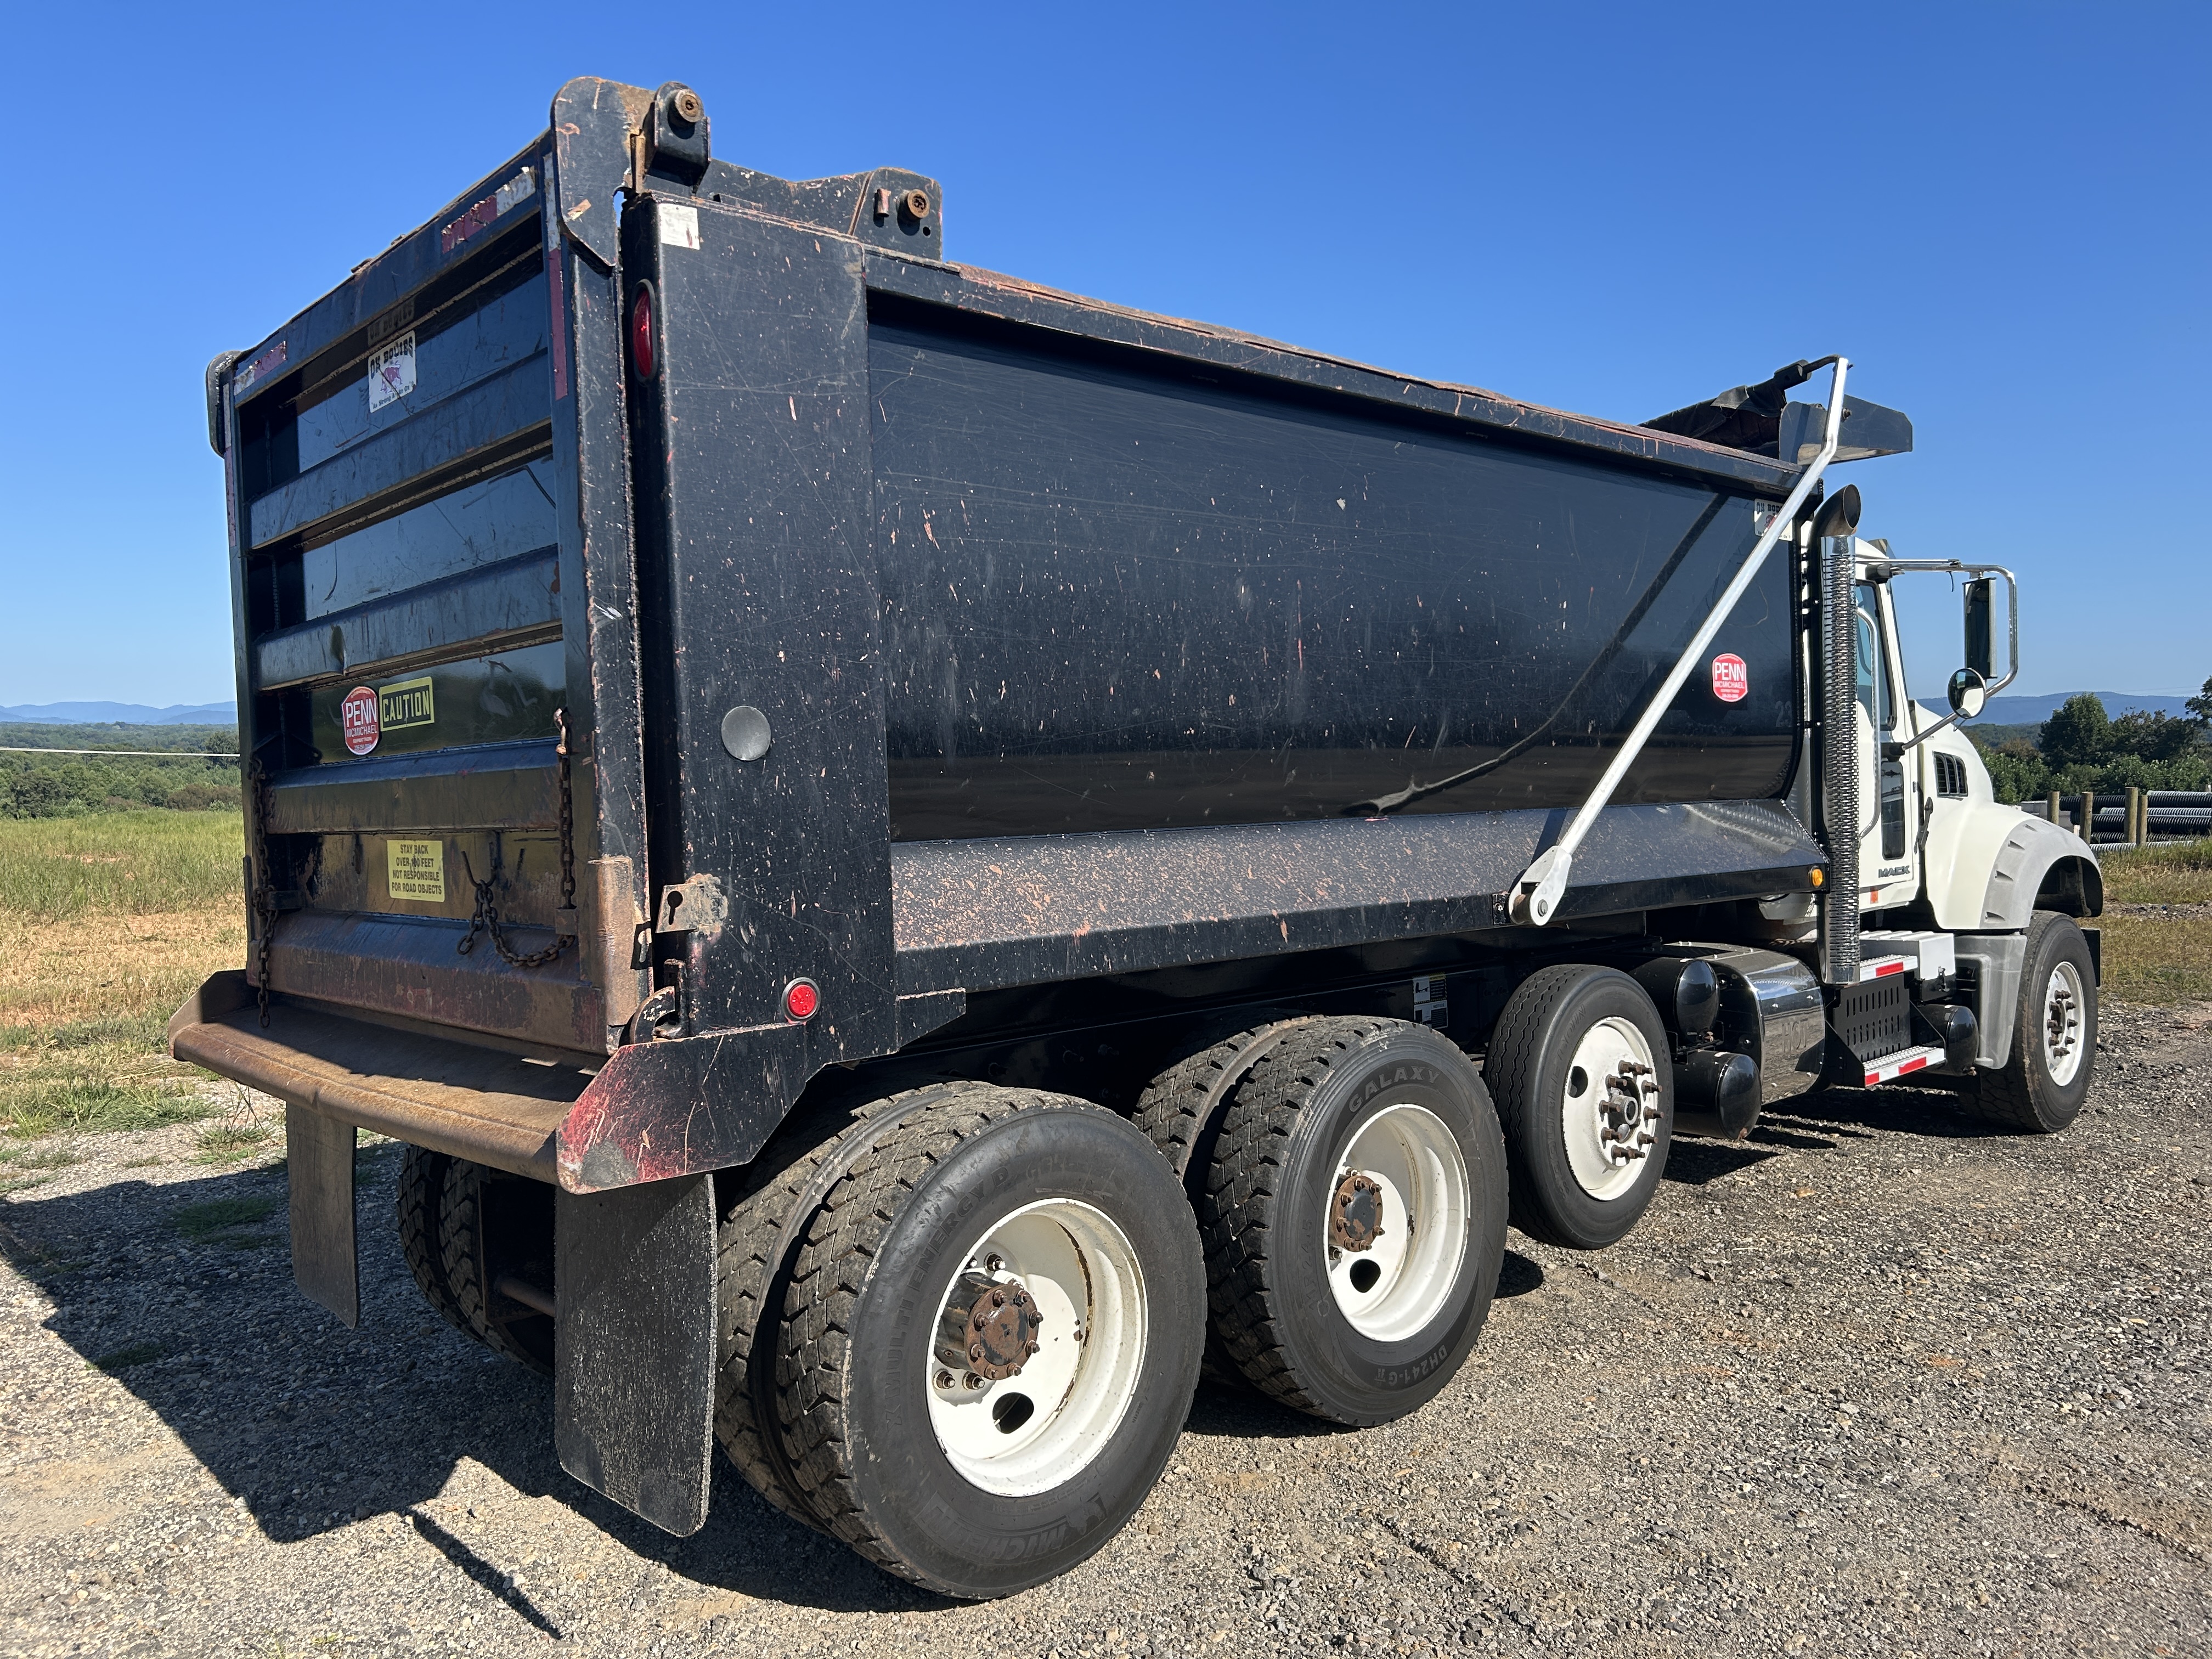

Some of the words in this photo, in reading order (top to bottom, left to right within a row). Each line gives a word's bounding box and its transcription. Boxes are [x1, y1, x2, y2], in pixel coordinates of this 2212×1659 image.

[370, 355, 381, 380] OX
[1756, 502, 1765, 515] OX
[1768, 504, 1783, 514] BOD
[1714, 662, 1744, 681] PENN
[345, 697, 377, 727] PENN
[383, 690, 430, 722] CAUTION
[400, 844, 413, 854] STAY
[414, 844, 428, 854] BACK
[396, 857, 410, 867] OVER
[421, 858, 434, 867] FEET
[392, 870, 402, 879] NOT
[403, 870, 439, 881] RESPONSIBLE
[1878, 865, 1910, 878] MACK
[392, 882, 401, 891] FOR
[402, 883, 416, 893] ROAD
[417, 884, 442, 895] OBJECTS
[1348, 1065, 1441, 1113] GALAXY
[885, 1297, 915, 1400] MULTI
[907, 1181, 986, 1291] ENERGY
[990, 1166, 1009, 1187] D
